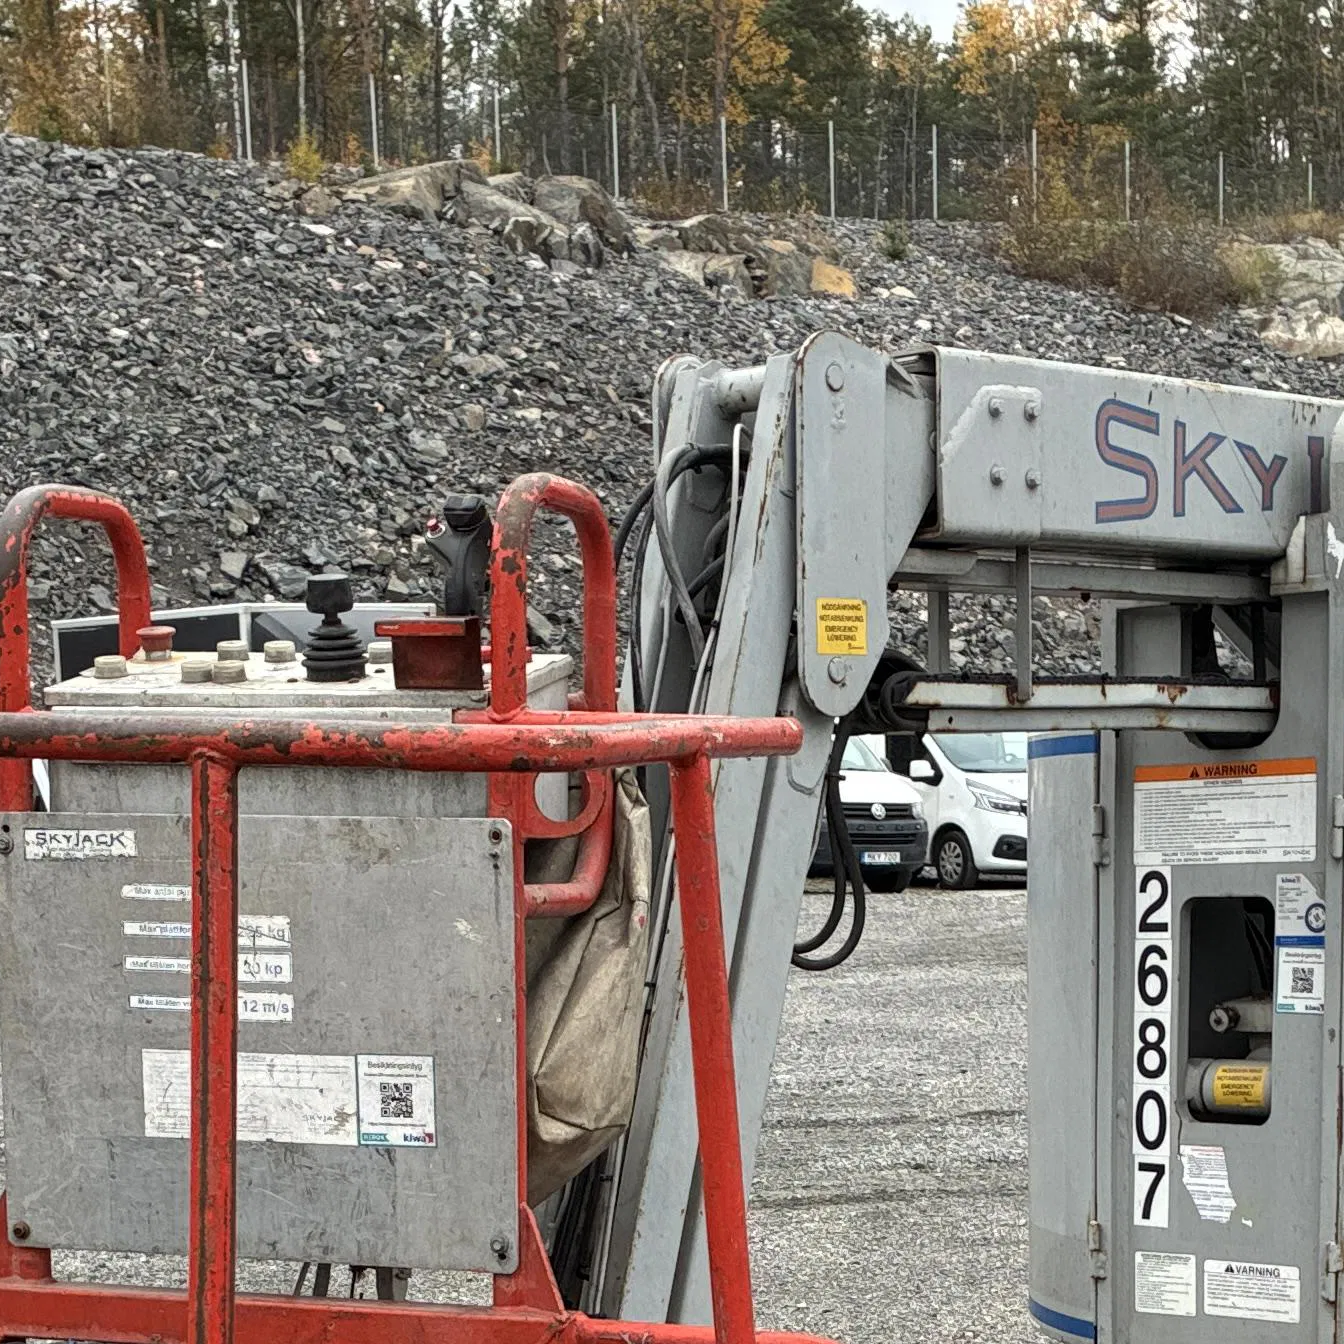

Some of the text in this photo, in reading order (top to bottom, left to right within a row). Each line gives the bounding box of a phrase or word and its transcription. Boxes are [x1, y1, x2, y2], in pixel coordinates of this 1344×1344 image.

[1204, 763, 1258, 777] WARNING
[35, 830, 127, 849] SKYJACK
[267, 924, 286, 941] kg
[265, 961, 283, 978] kp
[242, 999, 290, 1016] 12 m/s
[1235, 1264, 1281, 1278] VARNING
